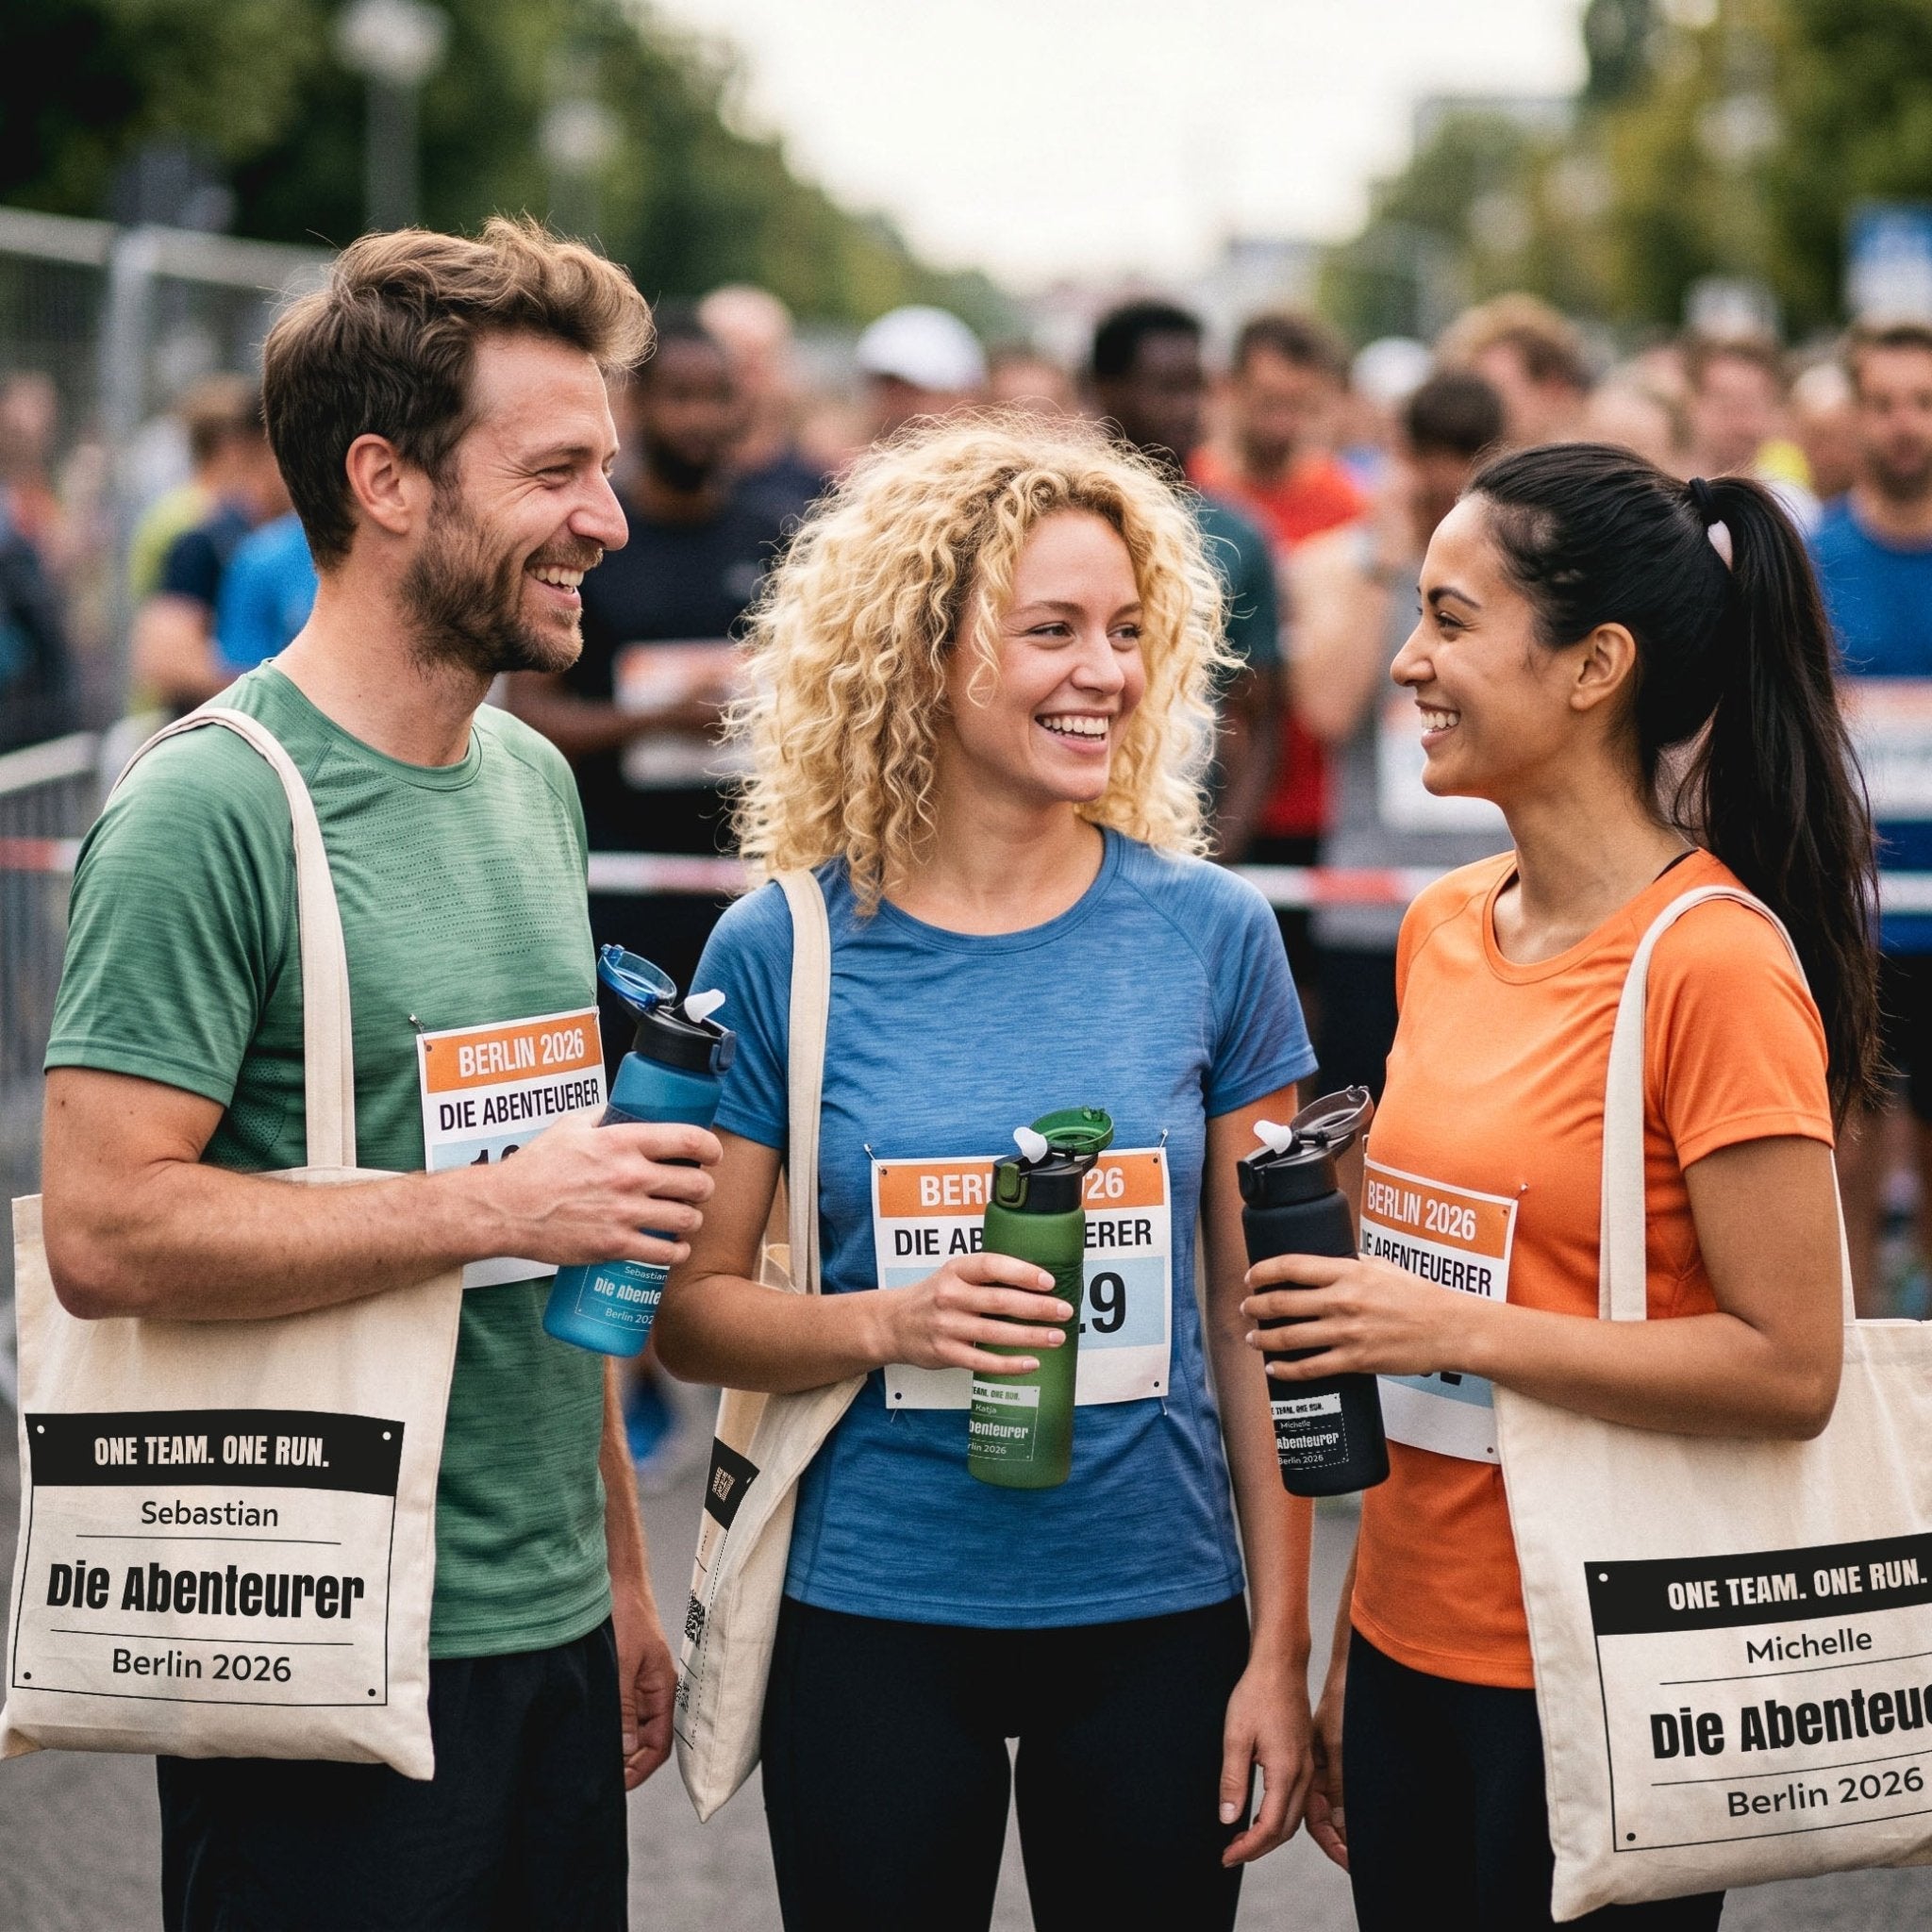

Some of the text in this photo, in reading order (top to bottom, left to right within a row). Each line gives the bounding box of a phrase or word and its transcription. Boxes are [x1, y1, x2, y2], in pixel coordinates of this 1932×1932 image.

[458, 1028, 585, 1078] BERLIN 2026
[440, 1077, 600, 1131] DIE ABENTEUERER
[1082, 1166, 1124, 1200] 26
[1368, 1179, 1477, 1241] BERLIN 2026
[894, 1228, 941, 1257] DIE
[594, 1276, 616, 1296] Die
[605, 1307, 634, 1323] Berlin
[975, 1404, 997, 1415] Katja
[1280, 1420, 1311, 1429] Michelle
[94, 1435, 330, 1468] ONE TEAM. ONE RUN.
[983, 1444, 1007, 1455] 2026
[1278, 1454, 1324, 1465] Berlin 2026
[141, 1500, 279, 1527] Sebastian
[46, 1559, 365, 1620] Die Abenteurer
[1667, 1558, 1928, 1611] ONE TEAM. ONE RUN.
[1746, 1627, 1873, 1664] Michelle
[112, 1648, 292, 1683] Berlin 2026
[1650, 1707, 1725, 1759] Die
[1727, 1767, 1924, 1818] Berlin 2026
